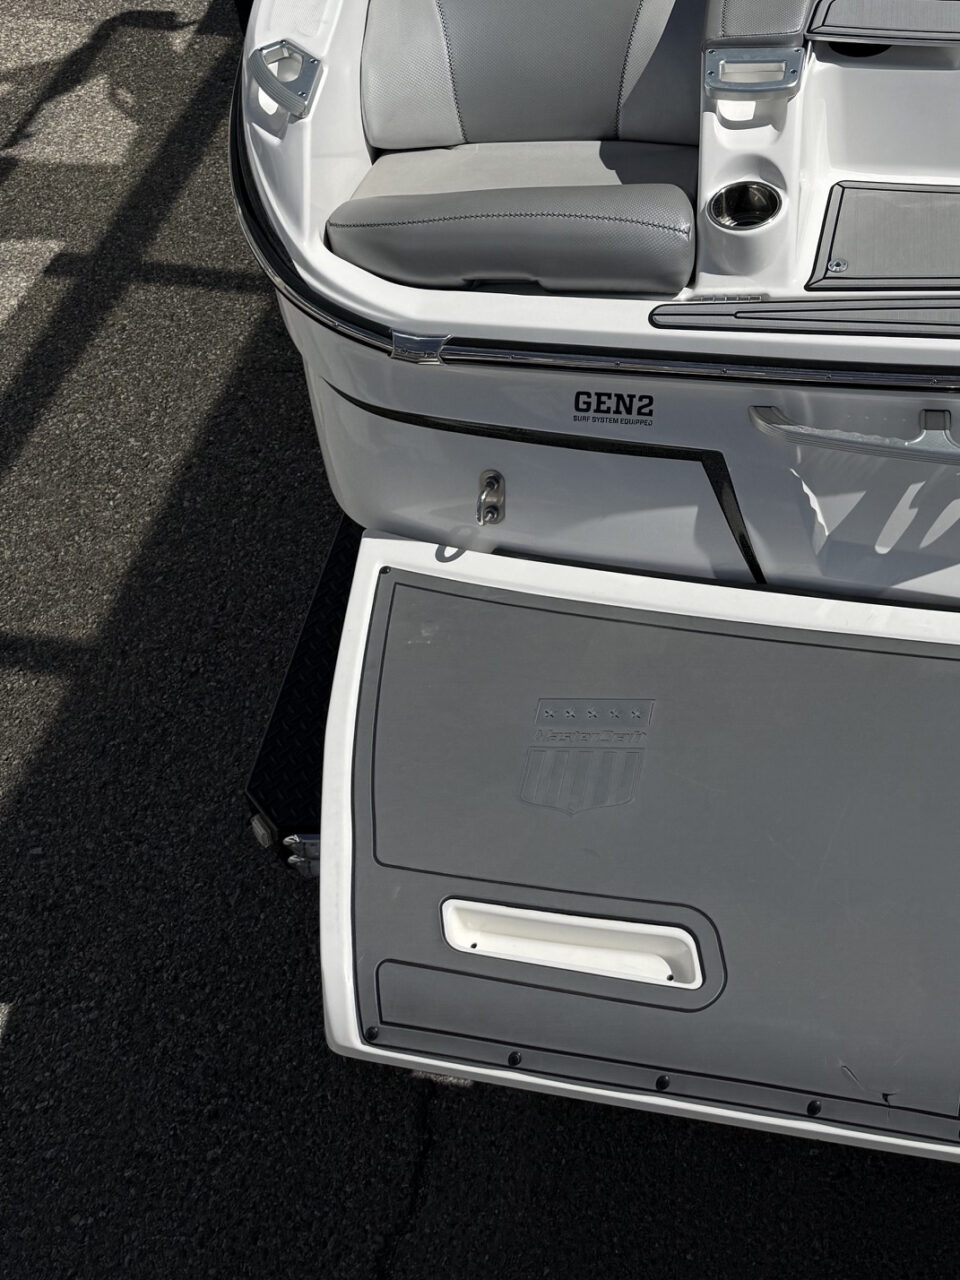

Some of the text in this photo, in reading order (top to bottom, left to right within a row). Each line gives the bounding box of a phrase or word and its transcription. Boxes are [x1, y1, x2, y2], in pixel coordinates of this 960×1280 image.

[573, 390, 654, 417] GEN2
[573, 415, 653, 427] SURF SYSTEM EQUIPPED
